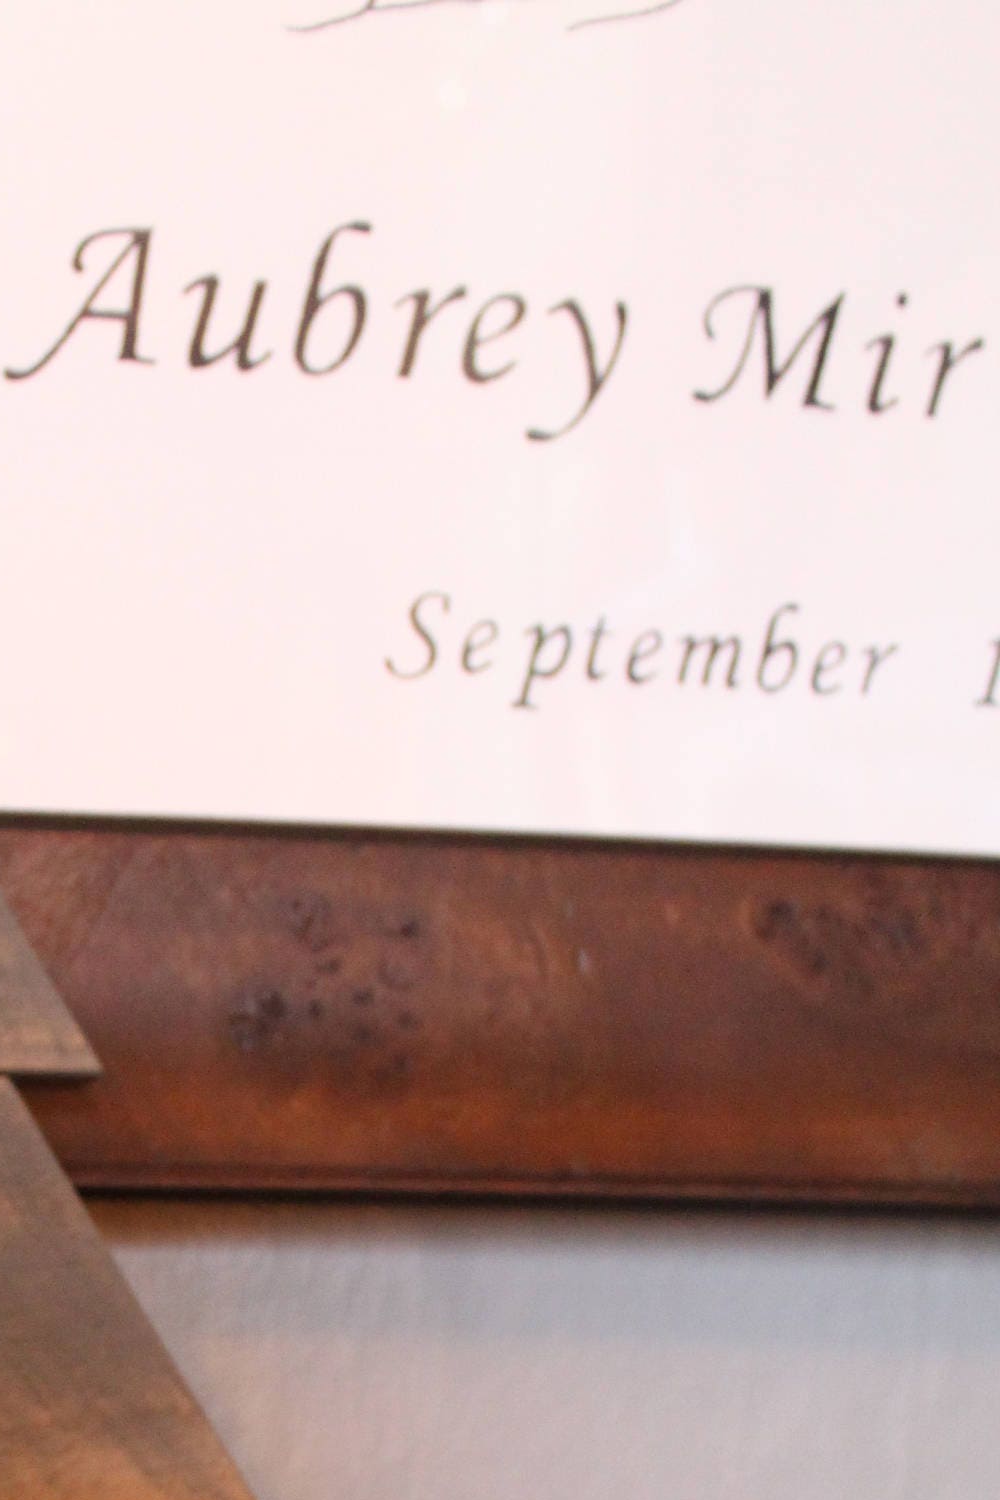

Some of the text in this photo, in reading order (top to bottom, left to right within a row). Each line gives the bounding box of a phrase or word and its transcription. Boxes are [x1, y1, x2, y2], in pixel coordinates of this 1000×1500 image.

[1, 219, 986, 443] Aubrey Mir
[384, 592, 899, 710] September
